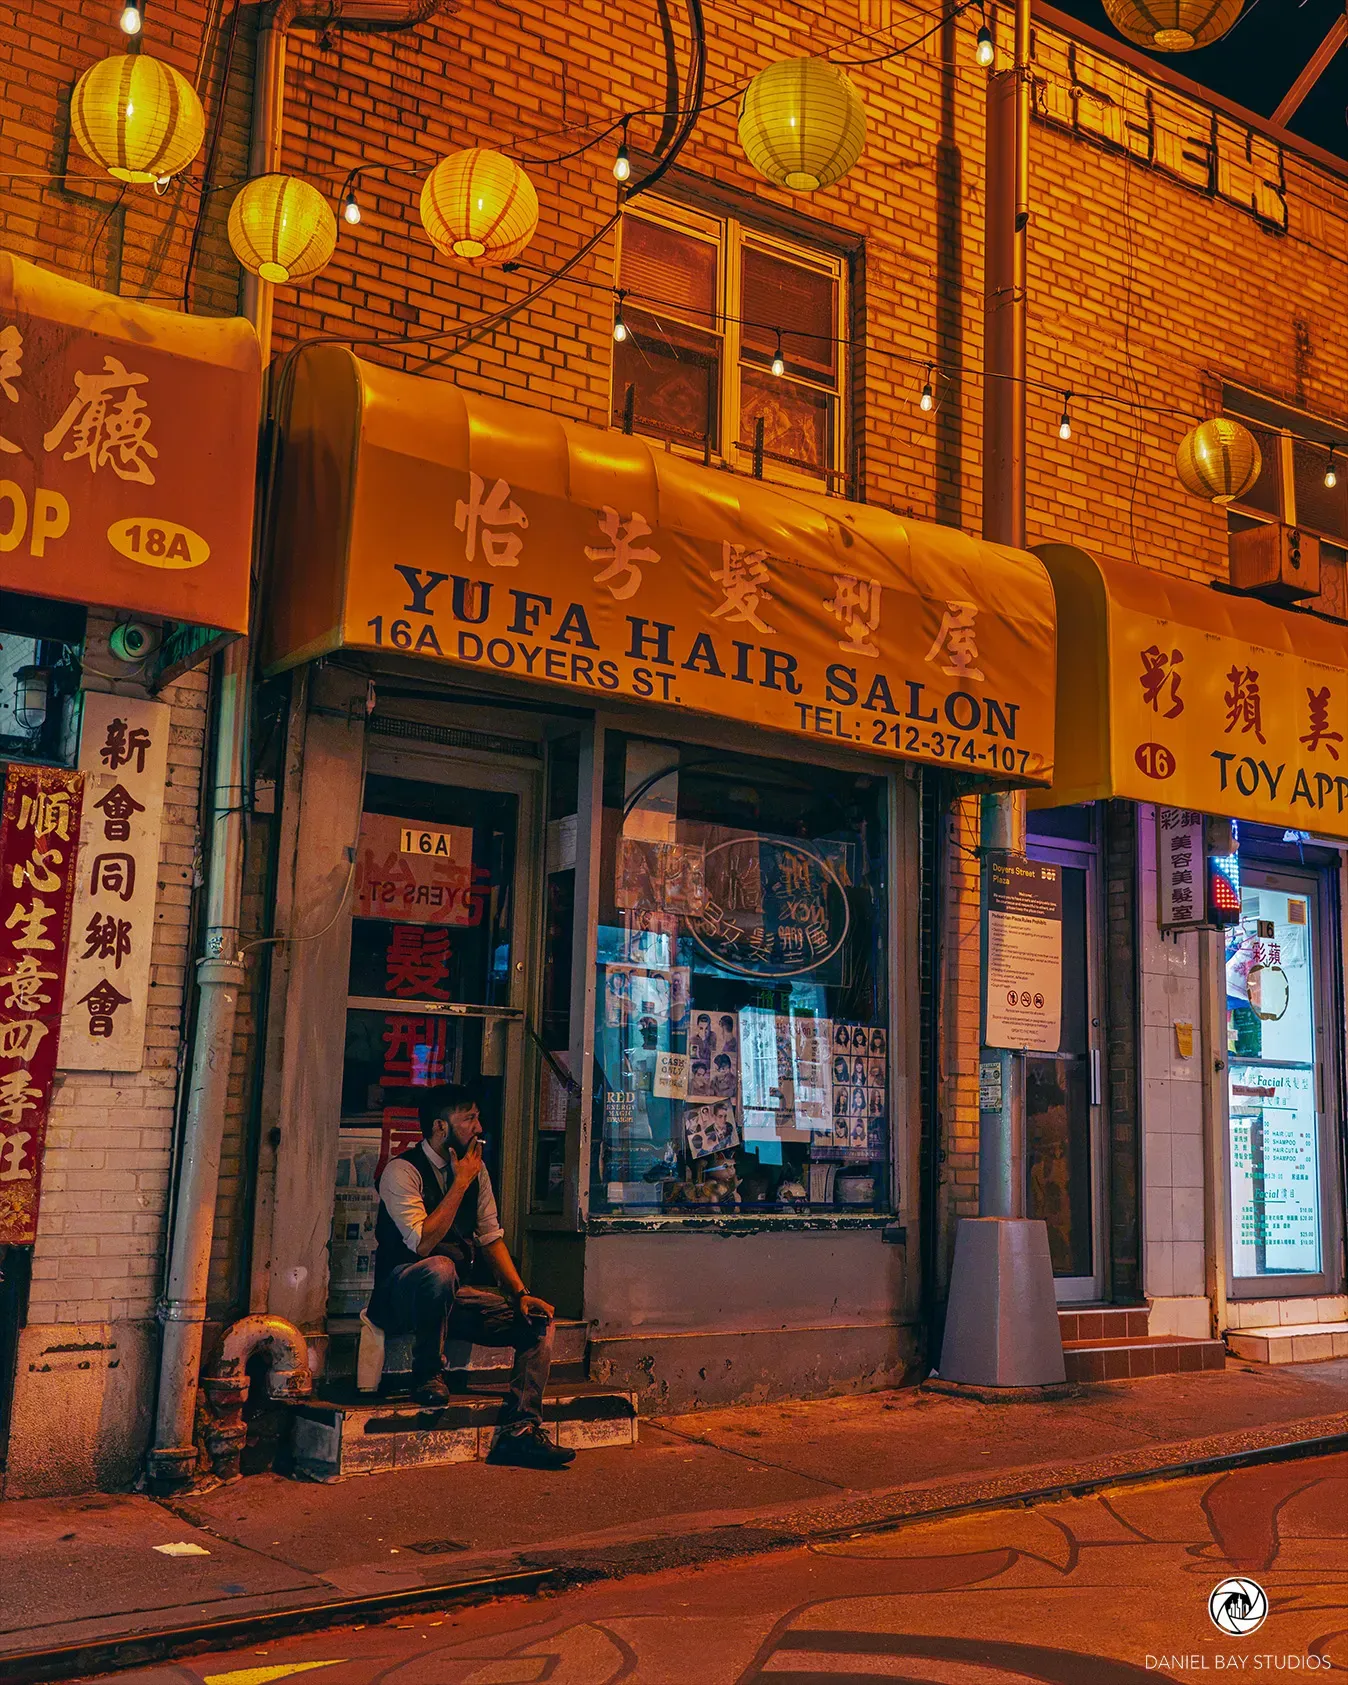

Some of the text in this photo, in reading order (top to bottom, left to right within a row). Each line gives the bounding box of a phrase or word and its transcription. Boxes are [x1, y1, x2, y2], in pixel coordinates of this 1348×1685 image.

[125, 524, 191, 562] 18A
[454, 471, 985, 682] 怡芳髮型屋
[367, 615, 681, 703] 16A DOYERS ST.
[394, 563, 1020, 741] YU FA HAIR SALON
[1139, 645, 1344, 761] 彩蘋美
[794, 702, 862, 741] TEL:
[1140, 747, 1169, 778] 16
[1210, 750, 1287, 801] TOY
[405, 831, 449, 856] 16A
[77, 718, 152, 1039] 新會同鄉會
[992, 863, 1035, 878] Doyers Street
[992, 875, 1010, 885] Plaza
[1171, 834, 1193, 921] 美容美髮室
[1259, 921, 1275, 938] 16
[1252, 942, 1282, 965] 彩蘋
[660, 1066, 684, 1076] ONLY
[661, 1056, 685, 1068] CASH
[1257, 1075, 1284, 1087] Facial
[606, 1091, 635, 1103] RED
[1254, 1188, 1279, 1198] Facial
